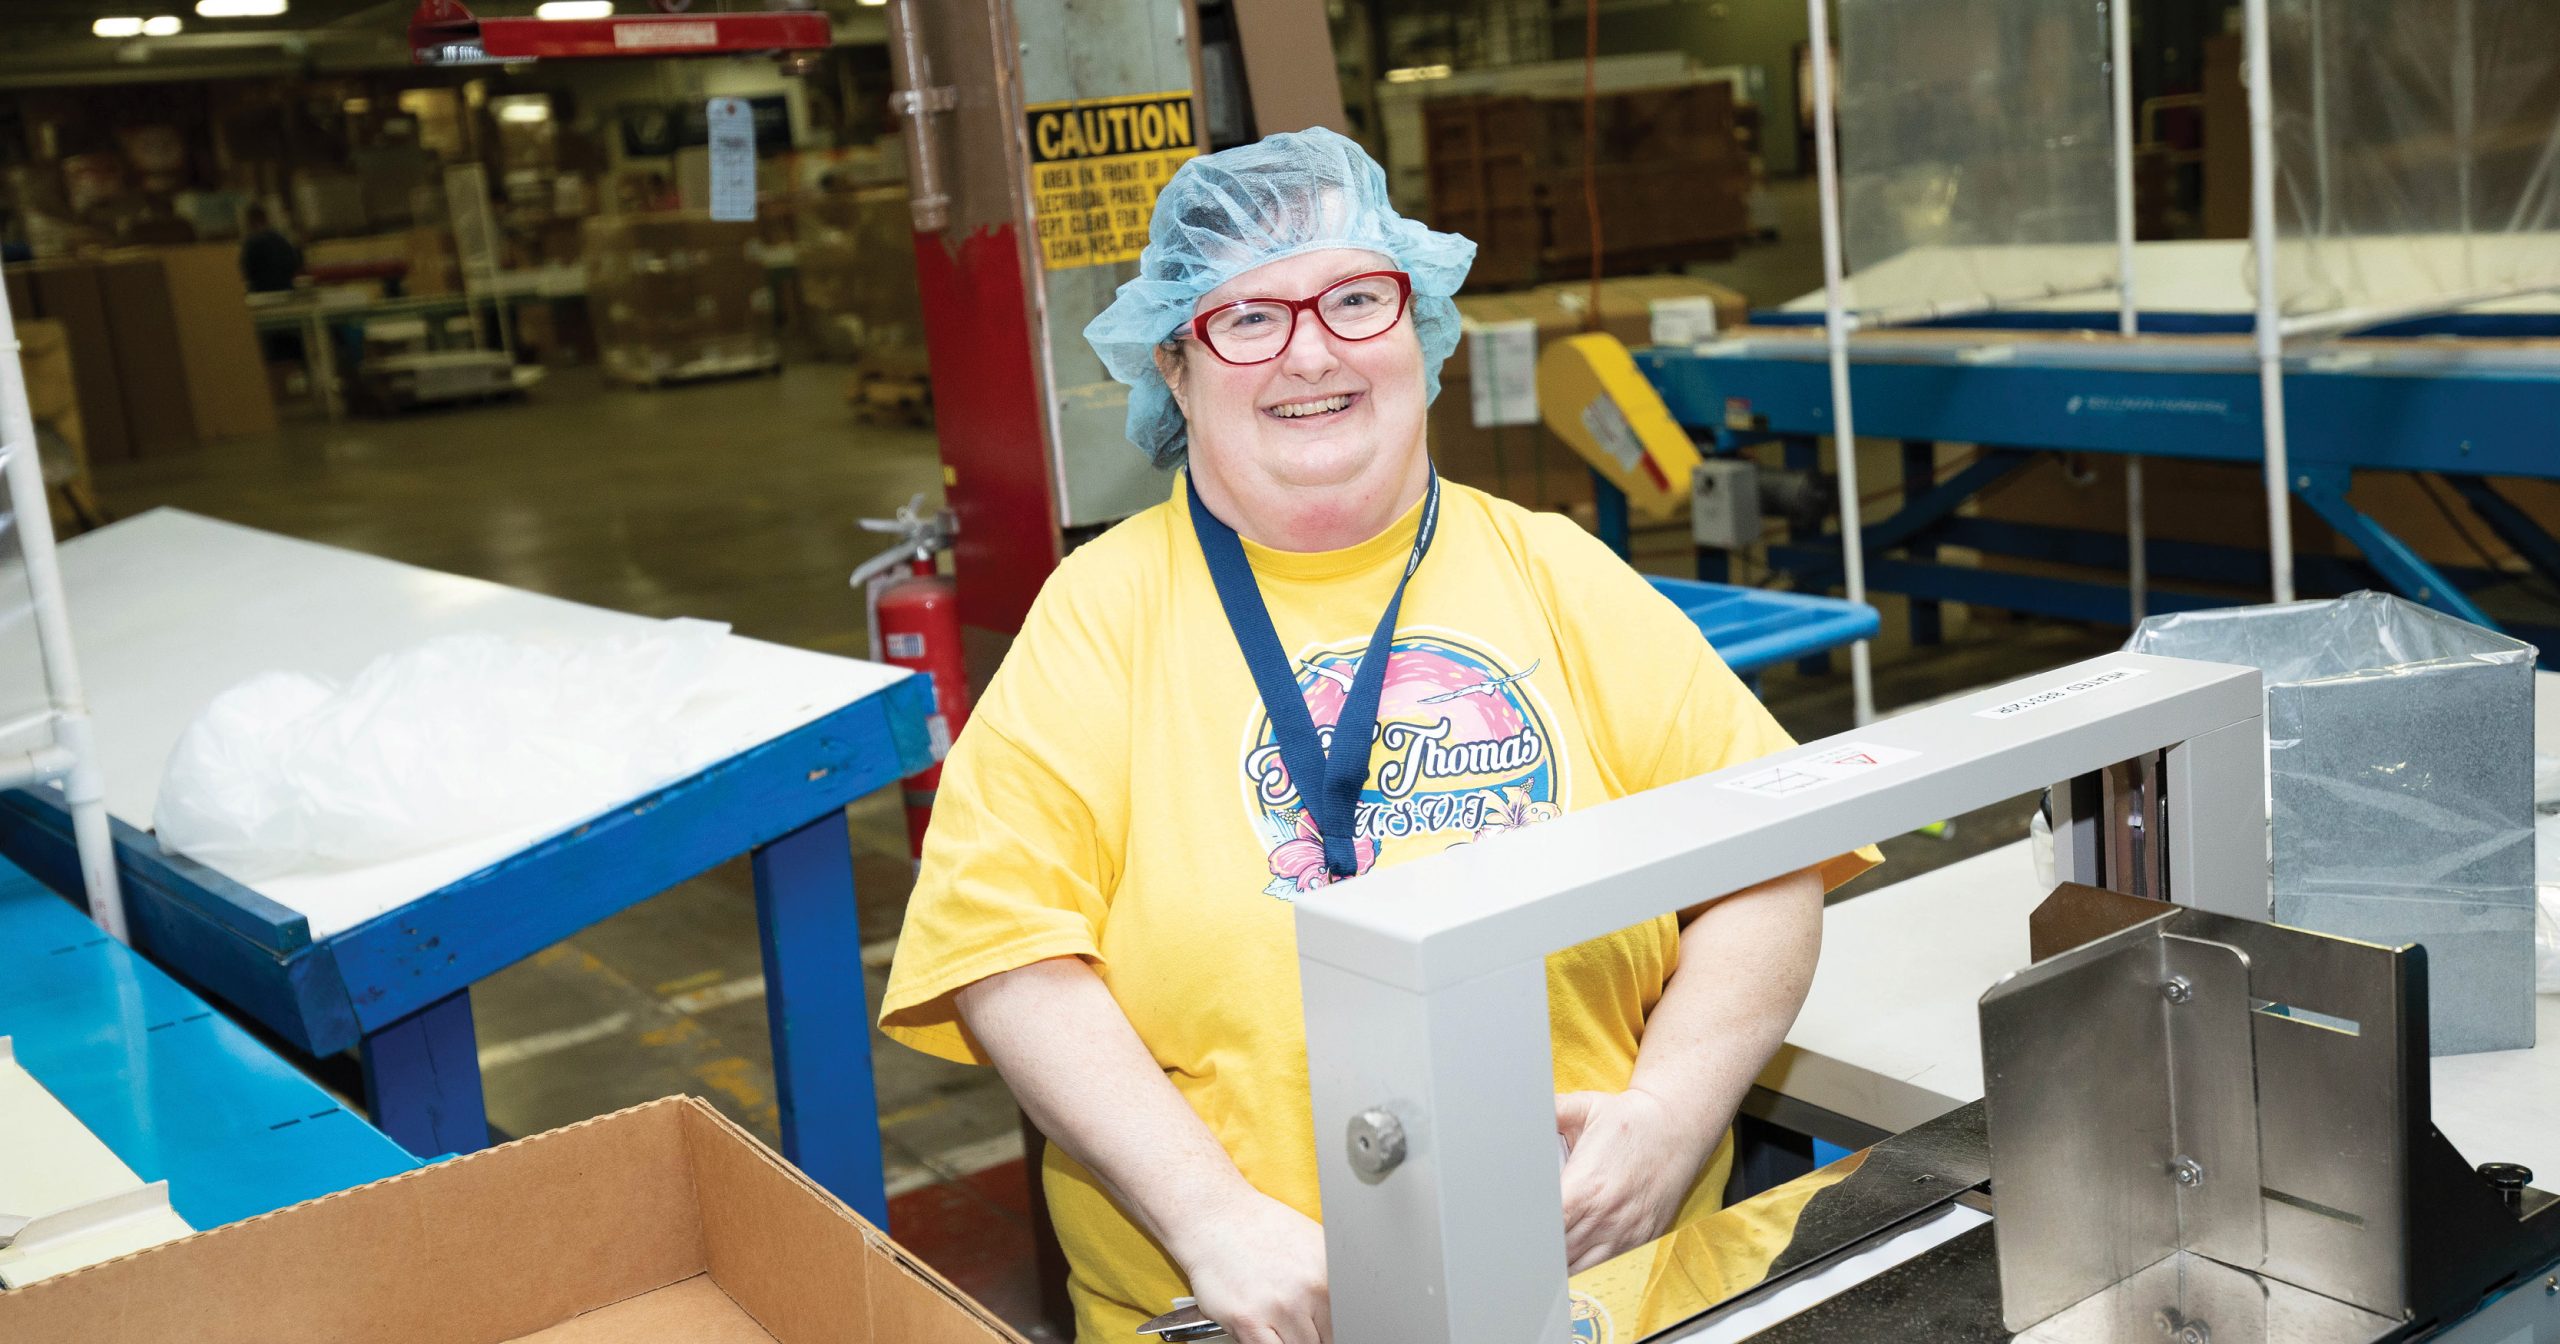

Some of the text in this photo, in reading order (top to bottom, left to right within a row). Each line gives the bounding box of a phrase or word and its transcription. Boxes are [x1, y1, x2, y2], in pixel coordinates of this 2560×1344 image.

[1036, 101, 1192, 159] CAUTION
[1043, 169, 1073, 189] AREA
[1079, 165, 1096, 185] IN
[1102, 160, 1138, 182] FRONT
[1146, 158, 1159, 177] OF
[1036, 190, 1105, 214] LECTRICAL
[1110, 185, 1148, 205] PANEL
[1039, 217, 1064, 238] EPT
[1070, 211, 1110, 233] CLEAR
[1116, 209, 1138, 227] FOR
[2066, 671, 2129, 691] HEATED
[1378, 716, 1542, 799] Thomas
